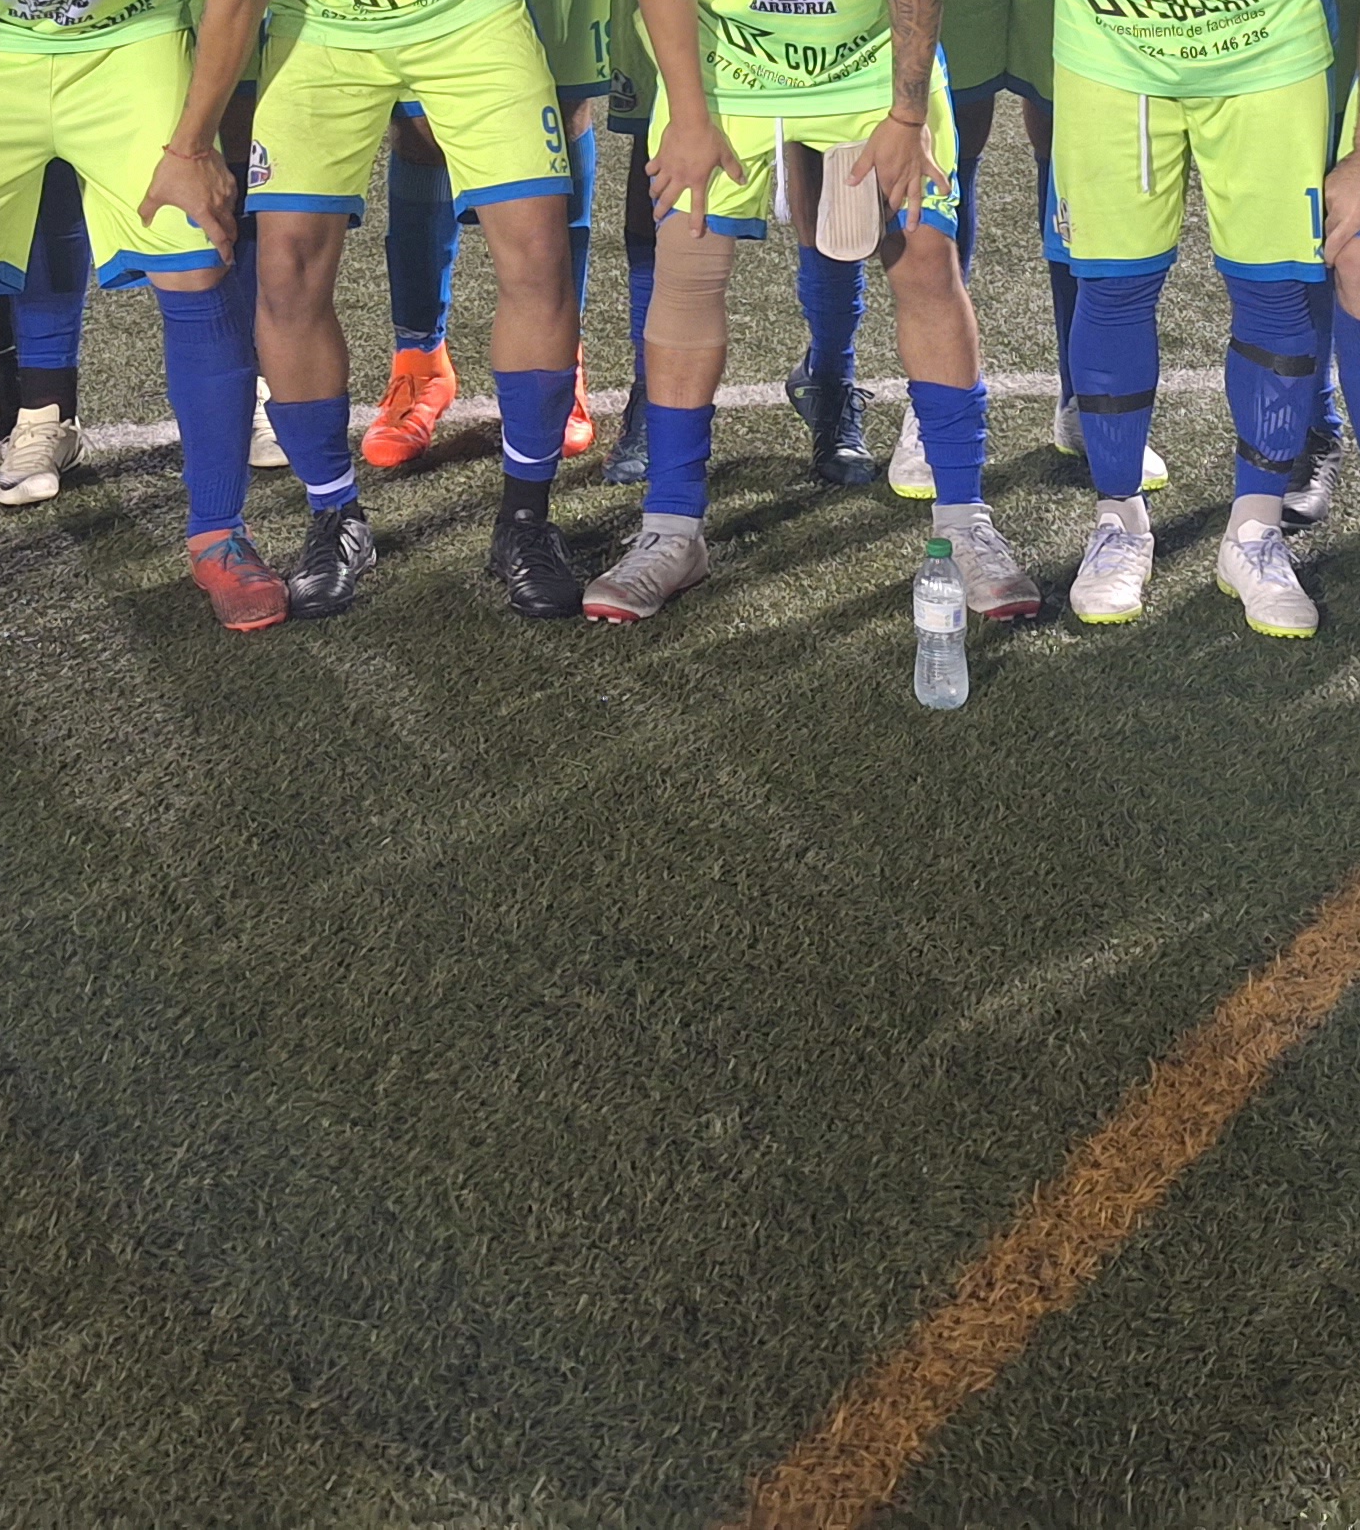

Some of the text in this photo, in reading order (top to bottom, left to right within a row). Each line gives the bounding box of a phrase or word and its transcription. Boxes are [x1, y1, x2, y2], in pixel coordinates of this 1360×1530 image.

[1187, 25, 1202, 38] de
[1207, 7, 1266, 32] fachadas
[1181, 46, 1208, 59] 604
[1213, 36, 1239, 55] 146
[1243, 27, 1269, 47] 236
[706, 51, 756, 89] 677 614
[541, 105, 562, 154] 9
[1305, 187, 1321, 239] 1
